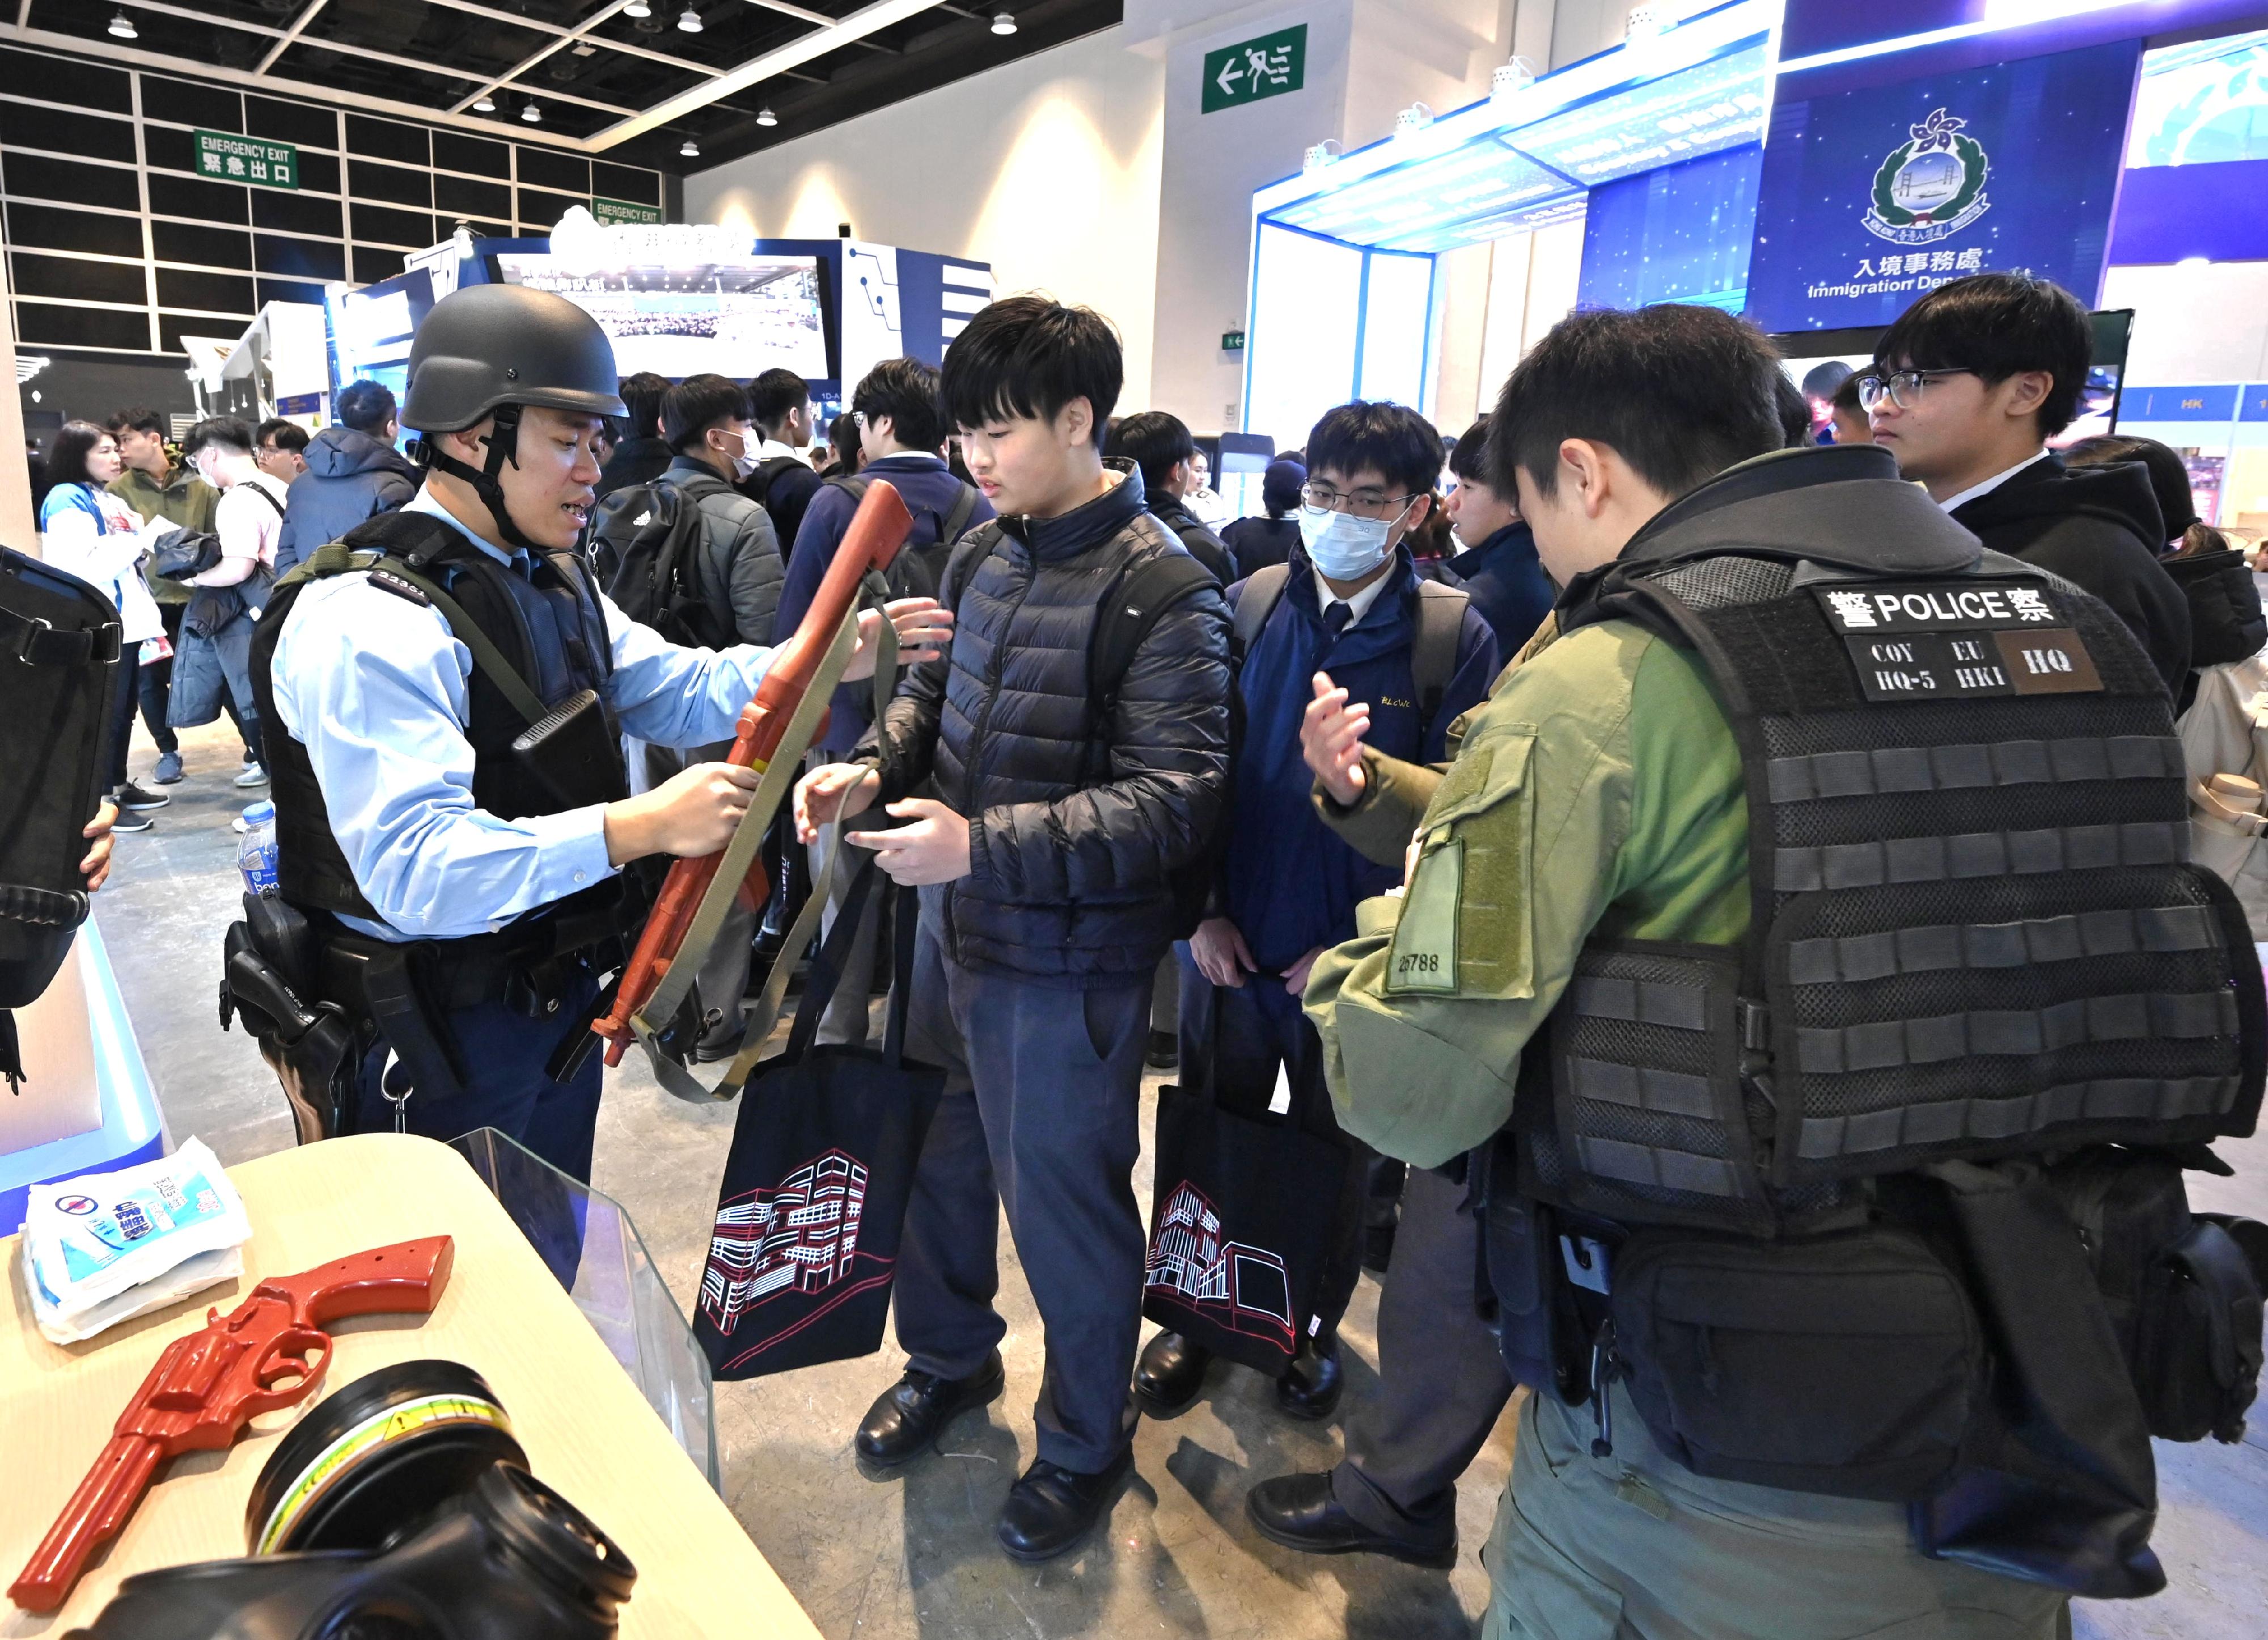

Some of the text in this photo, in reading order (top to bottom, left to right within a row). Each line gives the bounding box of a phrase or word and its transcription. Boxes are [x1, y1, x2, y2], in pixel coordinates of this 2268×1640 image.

[201, 136, 290, 163] EMERGENCY EXIT
[202, 151, 290, 183] 緊急出口
[597, 203, 641, 220] EMERGENCY
[642, 211, 657, 223] EXIT
[1854, 248, 1983, 278] 入境事務處
[1808, 279, 1915, 298] Immigration
[1874, 591, 2011, 622] POLICE
[1871, 641, 1984, 662] COY EU
[2022, 649, 2072, 674] HQ
[1875, 670, 1936, 690] HQ-5
